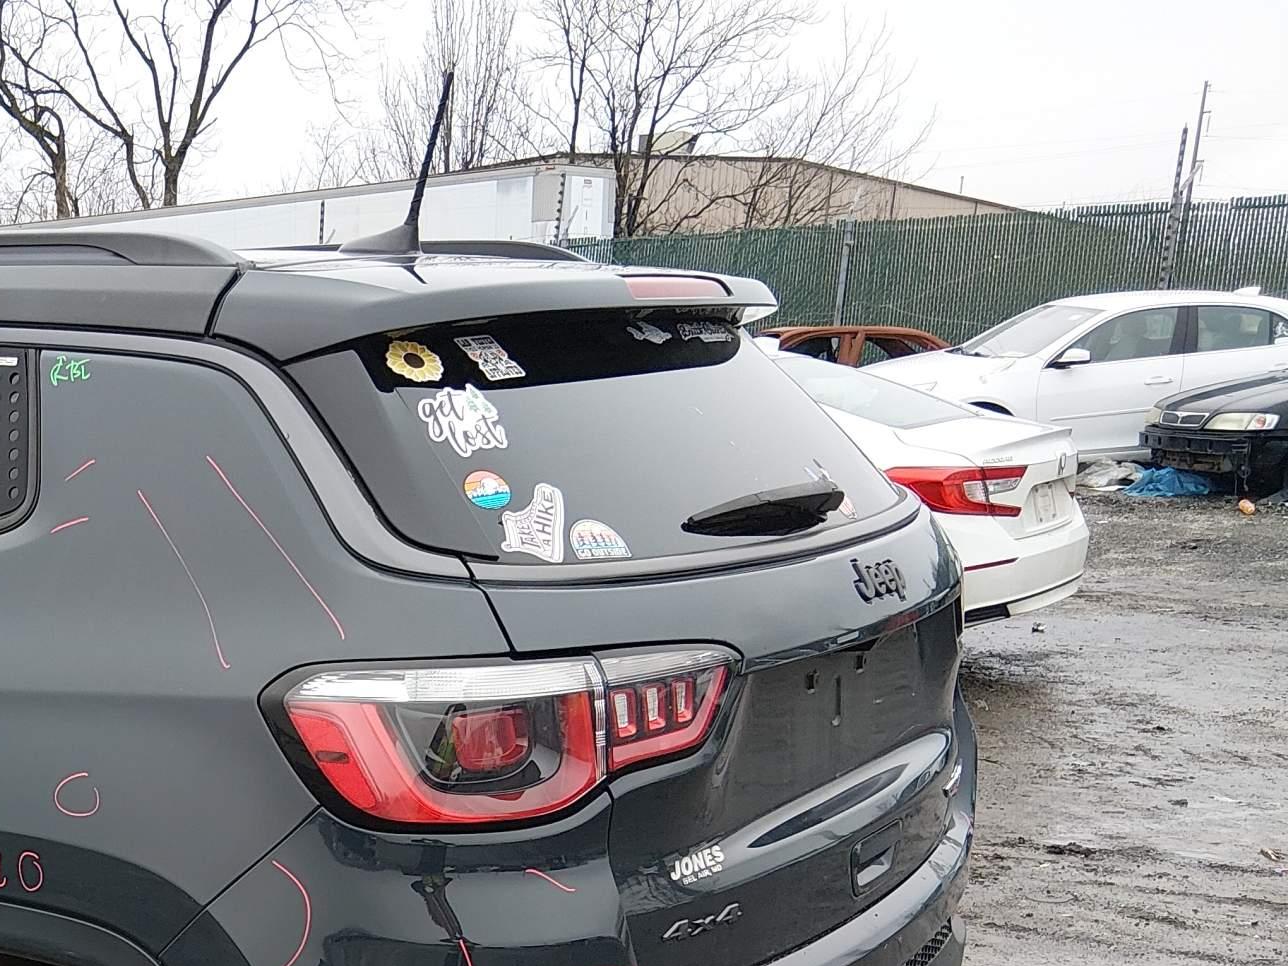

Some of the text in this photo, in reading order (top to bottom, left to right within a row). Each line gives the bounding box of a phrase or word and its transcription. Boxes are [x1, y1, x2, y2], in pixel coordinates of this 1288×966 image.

[422, 391, 464, 438] get
[448, 414, 504, 454] lost
[534, 490, 554, 536] HIKE
[516, 521, 541, 549] TAKE
[577, 547, 630, 557] GO OUTSIDE
[850, 558, 907, 604] Jeep
[670, 845, 725, 880] JONES
[682, 875, 698, 885] BEL
[662, 903, 742, 940] 4x4
